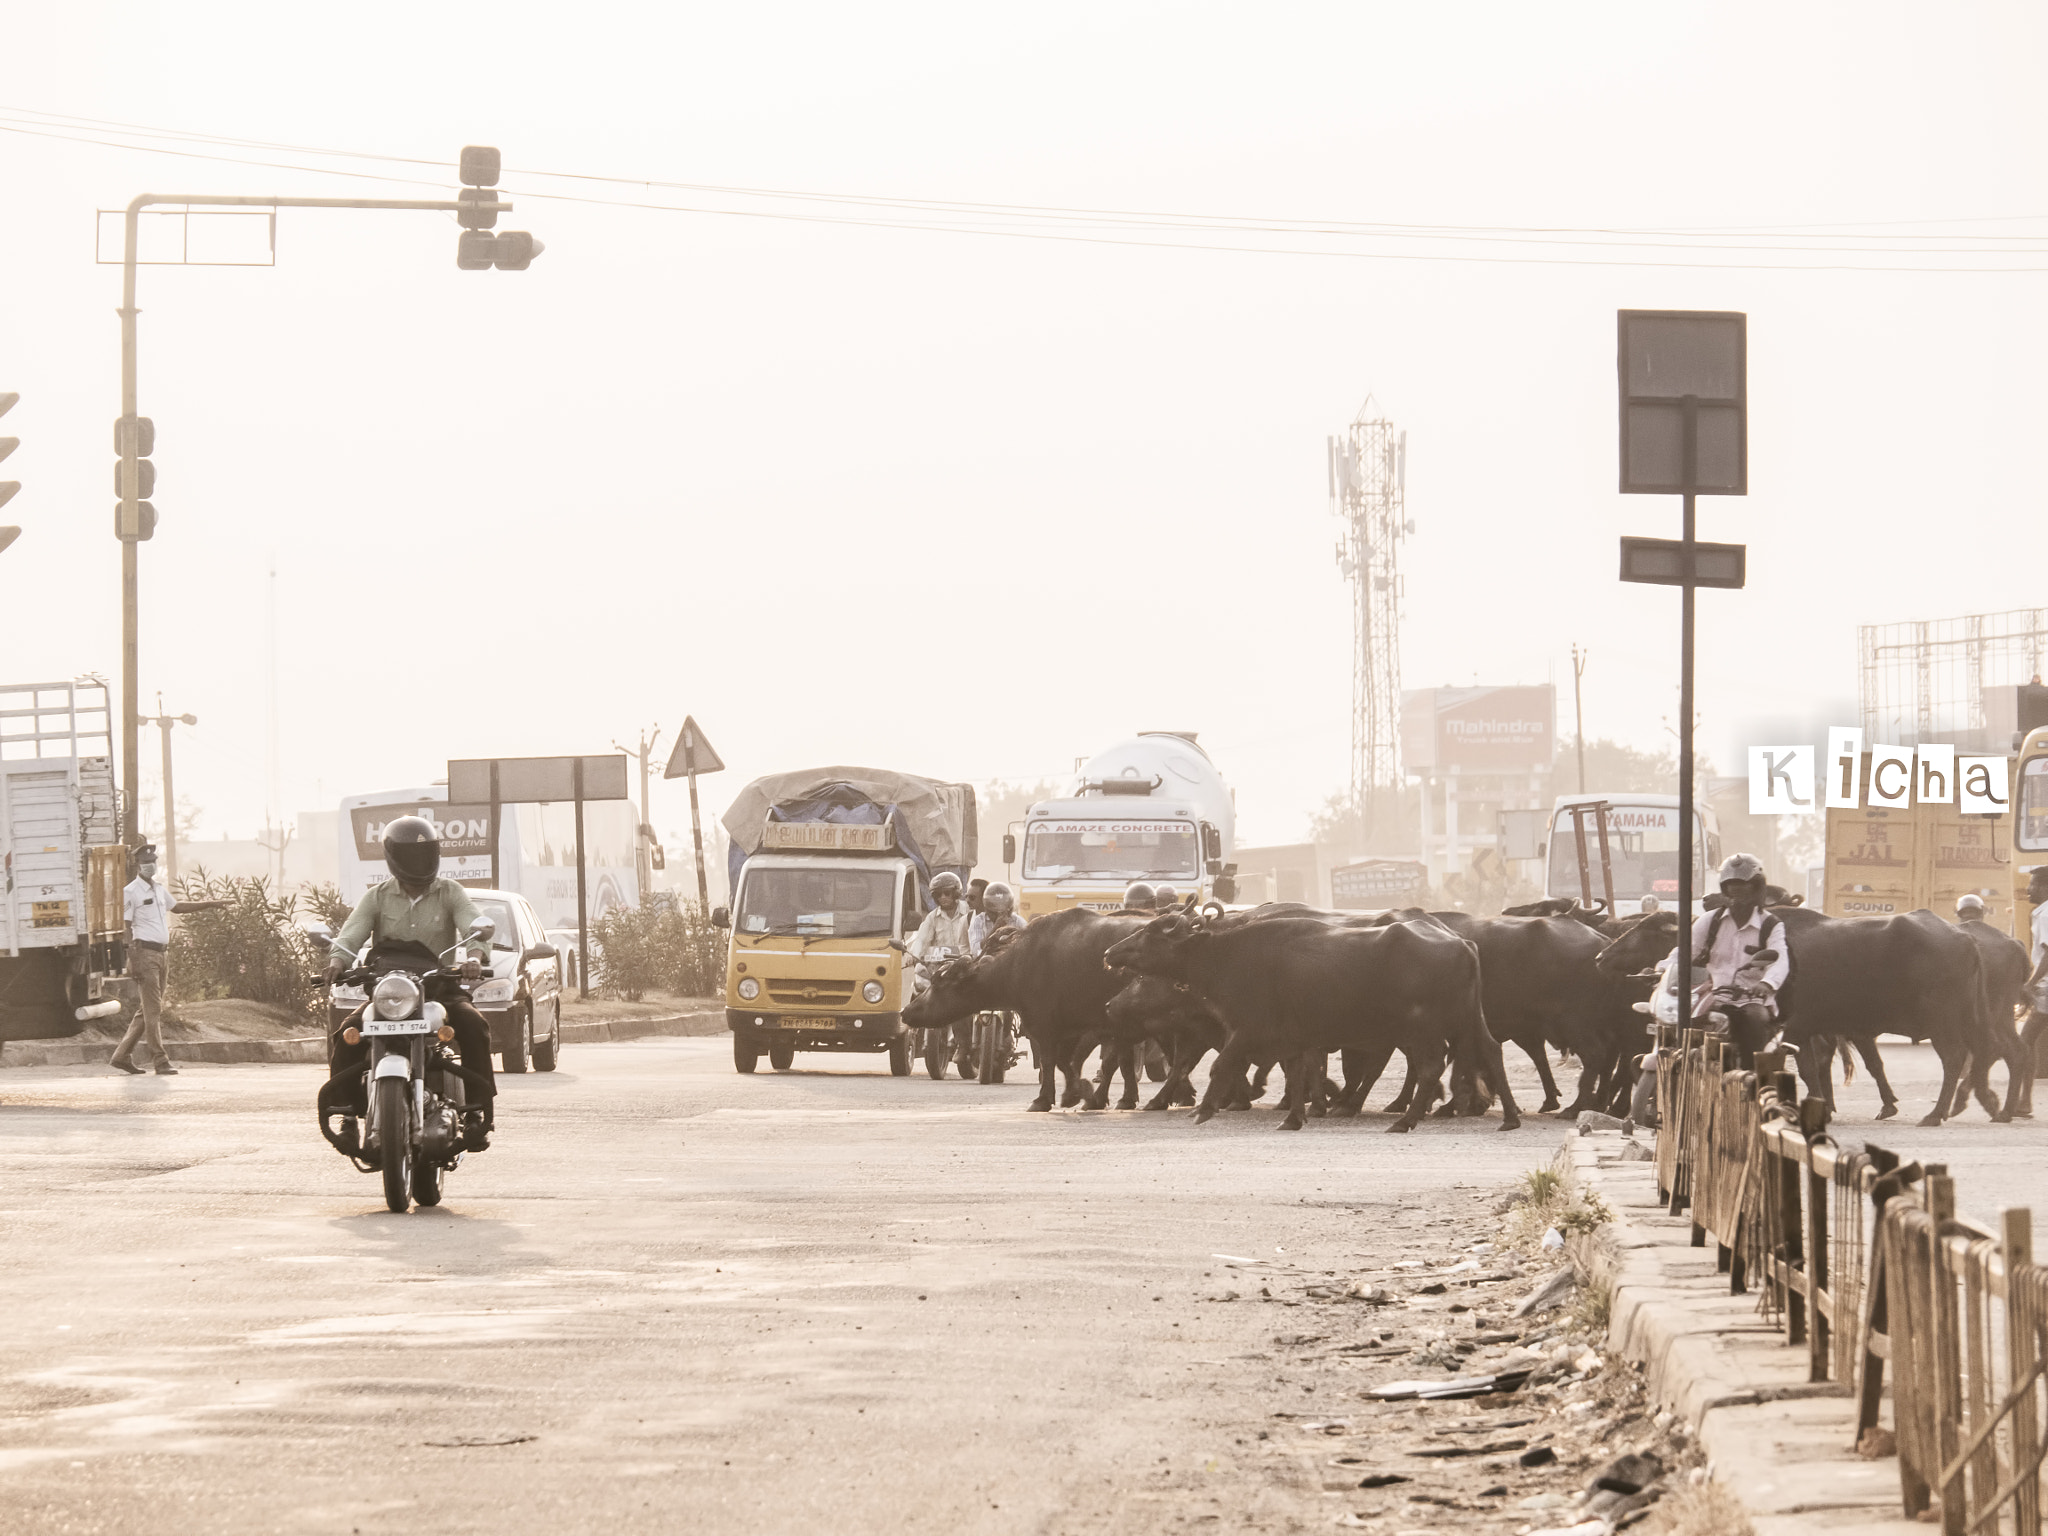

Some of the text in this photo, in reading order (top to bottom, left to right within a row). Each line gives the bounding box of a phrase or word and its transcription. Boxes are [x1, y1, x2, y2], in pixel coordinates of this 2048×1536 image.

[1446, 718, 1544, 734] Mahindra
[1605, 813, 1667, 828] YAMAHA
[365, 818, 488, 844] HRON
[1055, 824, 1193, 833] AMAZE CONCRETE
[1850, 844, 1894, 860] JAI
[1096, 903, 1122, 911] TATA
[1843, 902, 1895, 913] SOUND
